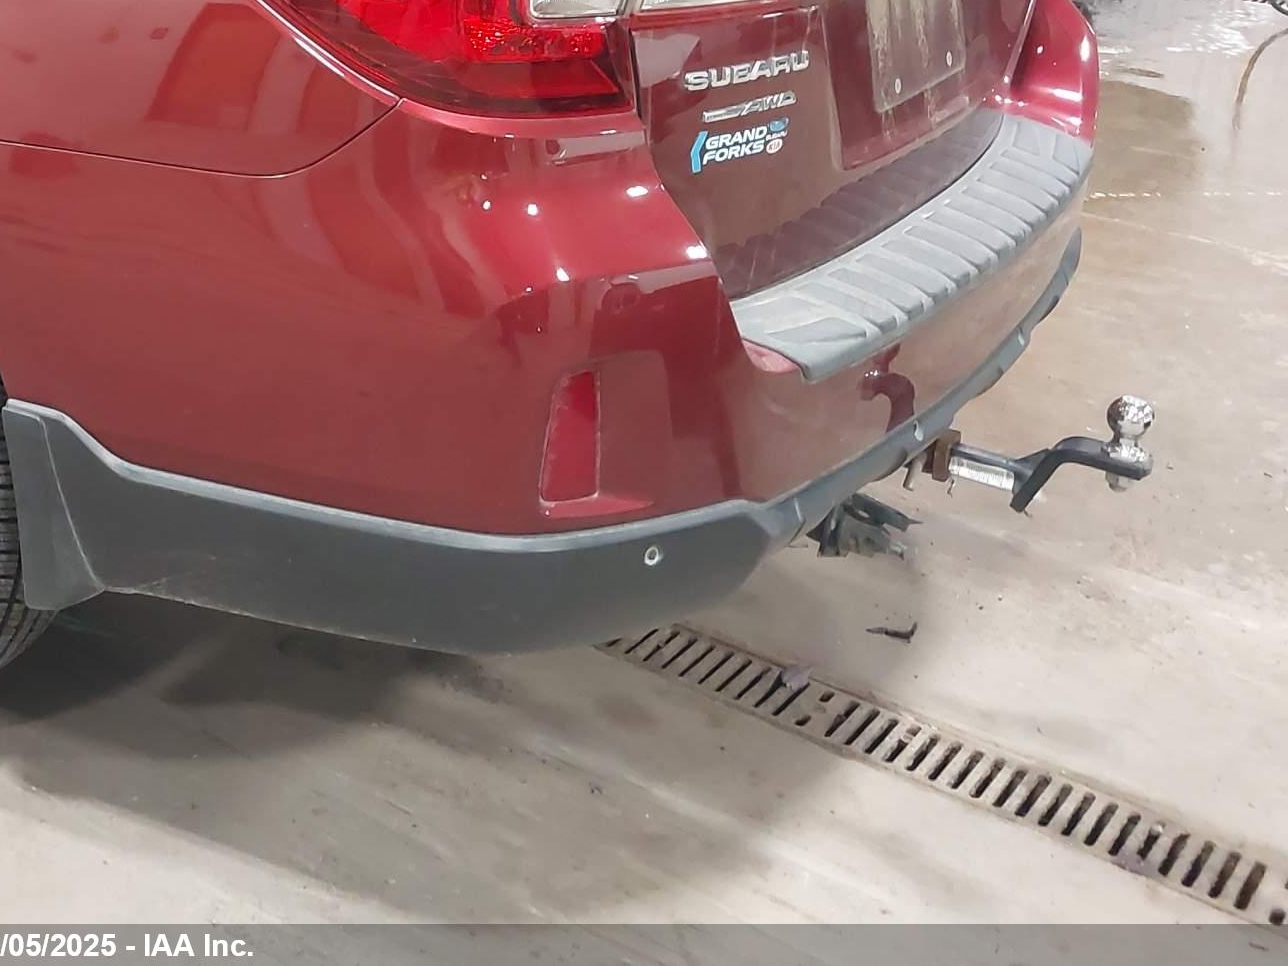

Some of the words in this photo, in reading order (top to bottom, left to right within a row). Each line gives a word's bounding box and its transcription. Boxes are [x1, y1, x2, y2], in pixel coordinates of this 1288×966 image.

[684, 50, 809, 90] SUBARU
[741, 90, 797, 116] AWD
[705, 126, 768, 150] GRAND
[702, 139, 765, 165] FORKS
